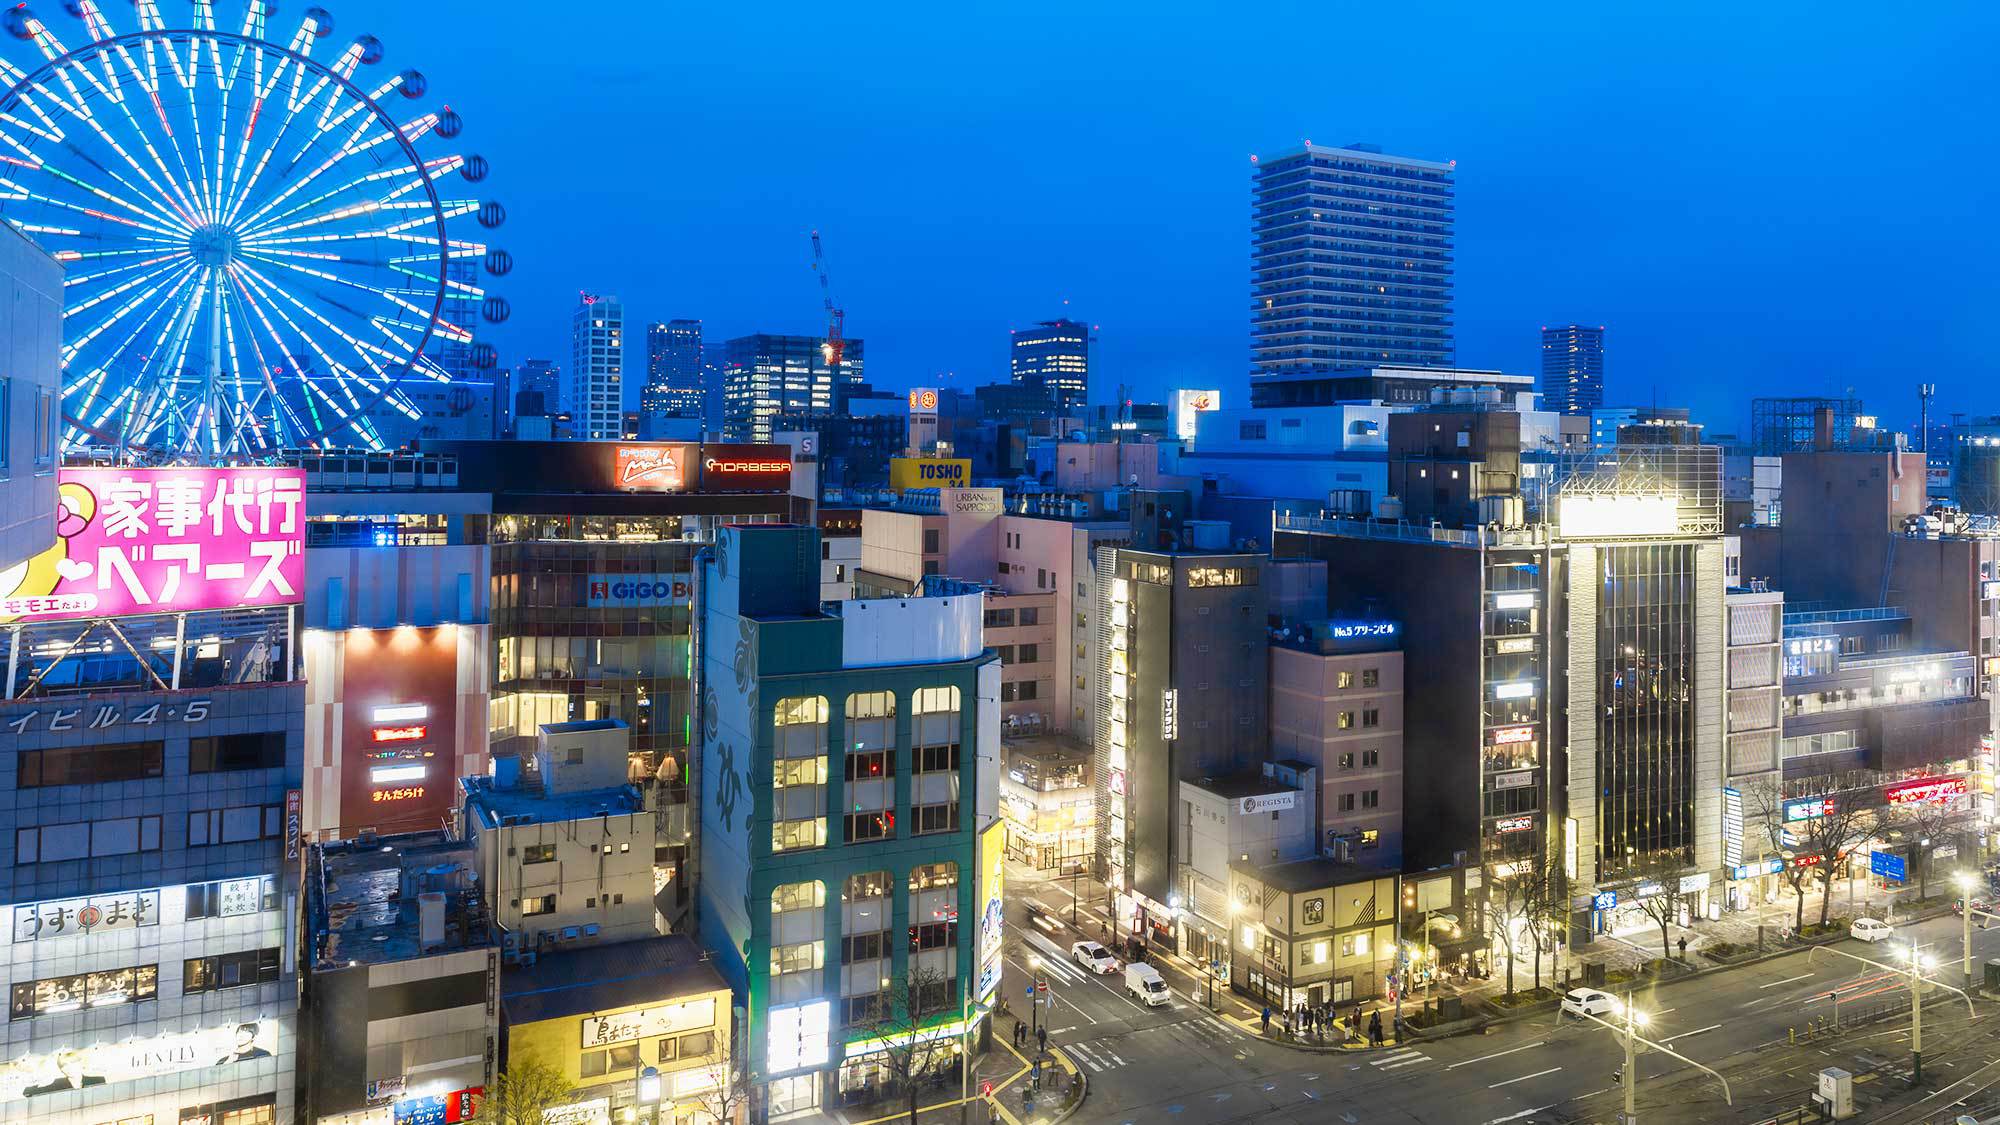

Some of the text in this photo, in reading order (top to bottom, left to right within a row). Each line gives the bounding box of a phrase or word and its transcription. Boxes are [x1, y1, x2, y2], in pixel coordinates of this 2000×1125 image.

[919, 464, 962, 479] TOSHO
[955, 493, 984, 501] URBAN
[100, 477, 302, 538] 家事代行
[97, 540, 301, 604] ベアーズ
[612, 582, 670, 599] GiGO
[1354, 624, 1394, 636] グリーンビル
[373, 787, 425, 801] まんだらけ
[1256, 797, 1292, 808] REGISTA
[288, 815, 299, 858] スライム
